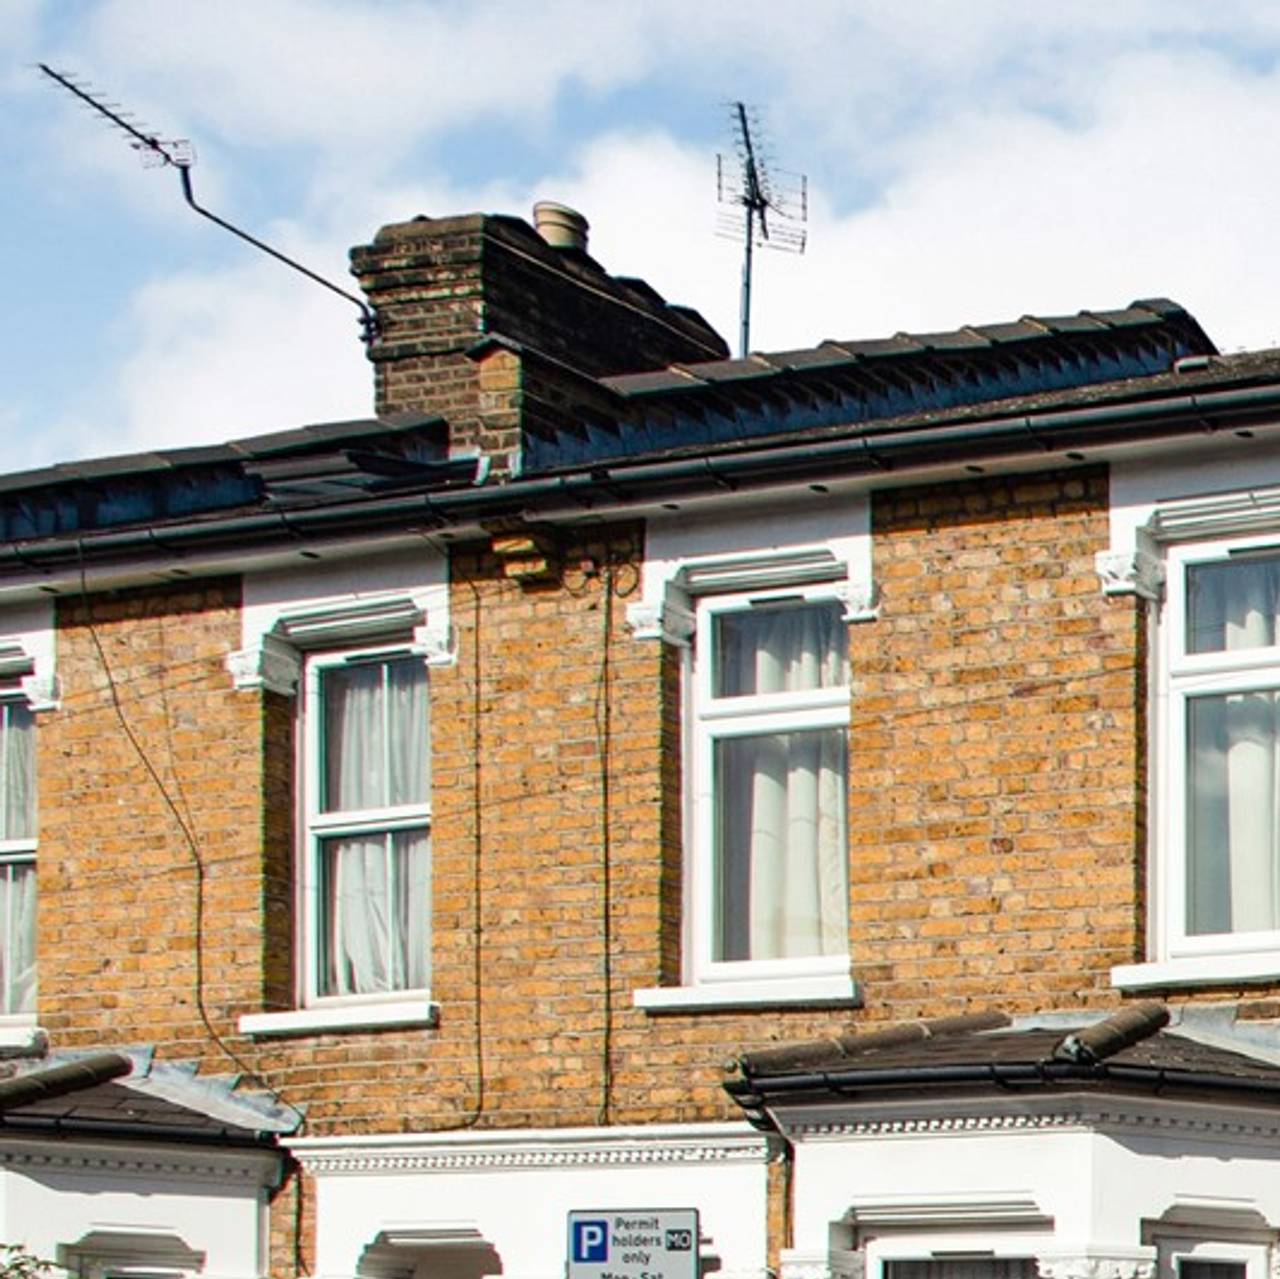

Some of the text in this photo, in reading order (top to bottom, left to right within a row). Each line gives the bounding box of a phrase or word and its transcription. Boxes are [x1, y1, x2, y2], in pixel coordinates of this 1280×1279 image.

[615, 1217, 660, 1230] Permit
[581, 1225, 604, 1259] P
[612, 1234, 662, 1248] holders
[621, 1251, 651, 1265] only
